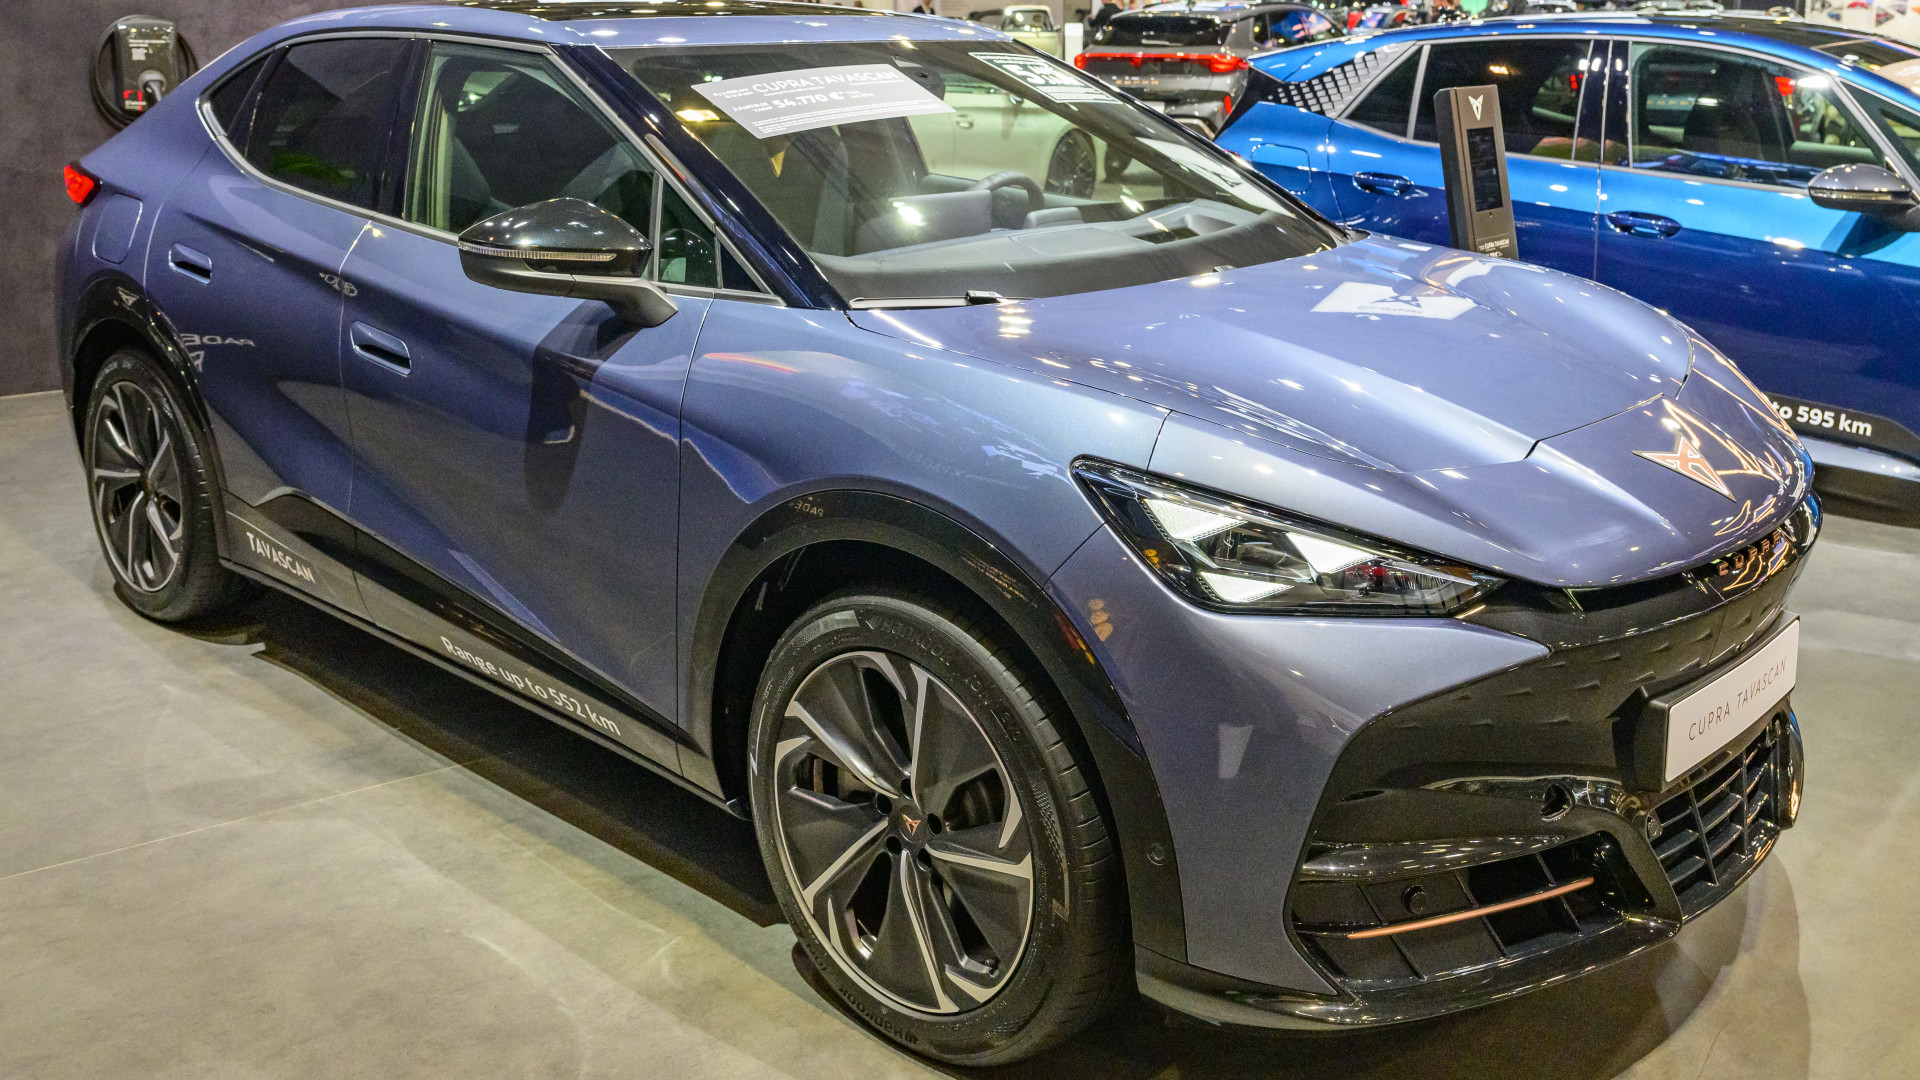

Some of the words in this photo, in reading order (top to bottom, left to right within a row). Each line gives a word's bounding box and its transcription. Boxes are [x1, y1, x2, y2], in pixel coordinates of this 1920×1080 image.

[752, 76, 813, 93] CUPRA
[813, 71, 900, 86] TAVASCAN
[774, 94, 828, 109] 54.770
[1796, 405, 1835, 428] 595
[1838, 413, 1873, 437] km
[246, 532, 316, 584] TAVASCAN
[1718, 530, 1782, 577] CUPRA
[440, 635, 498, 676] Range
[499, 667, 525, 690] up
[525, 677, 548, 699] to
[547, 687, 587, 719] 552
[584, 703, 622, 736] km
[1688, 701, 1731, 741] CUPRA
[1736, 656, 1788, 709] TAVASCAN
